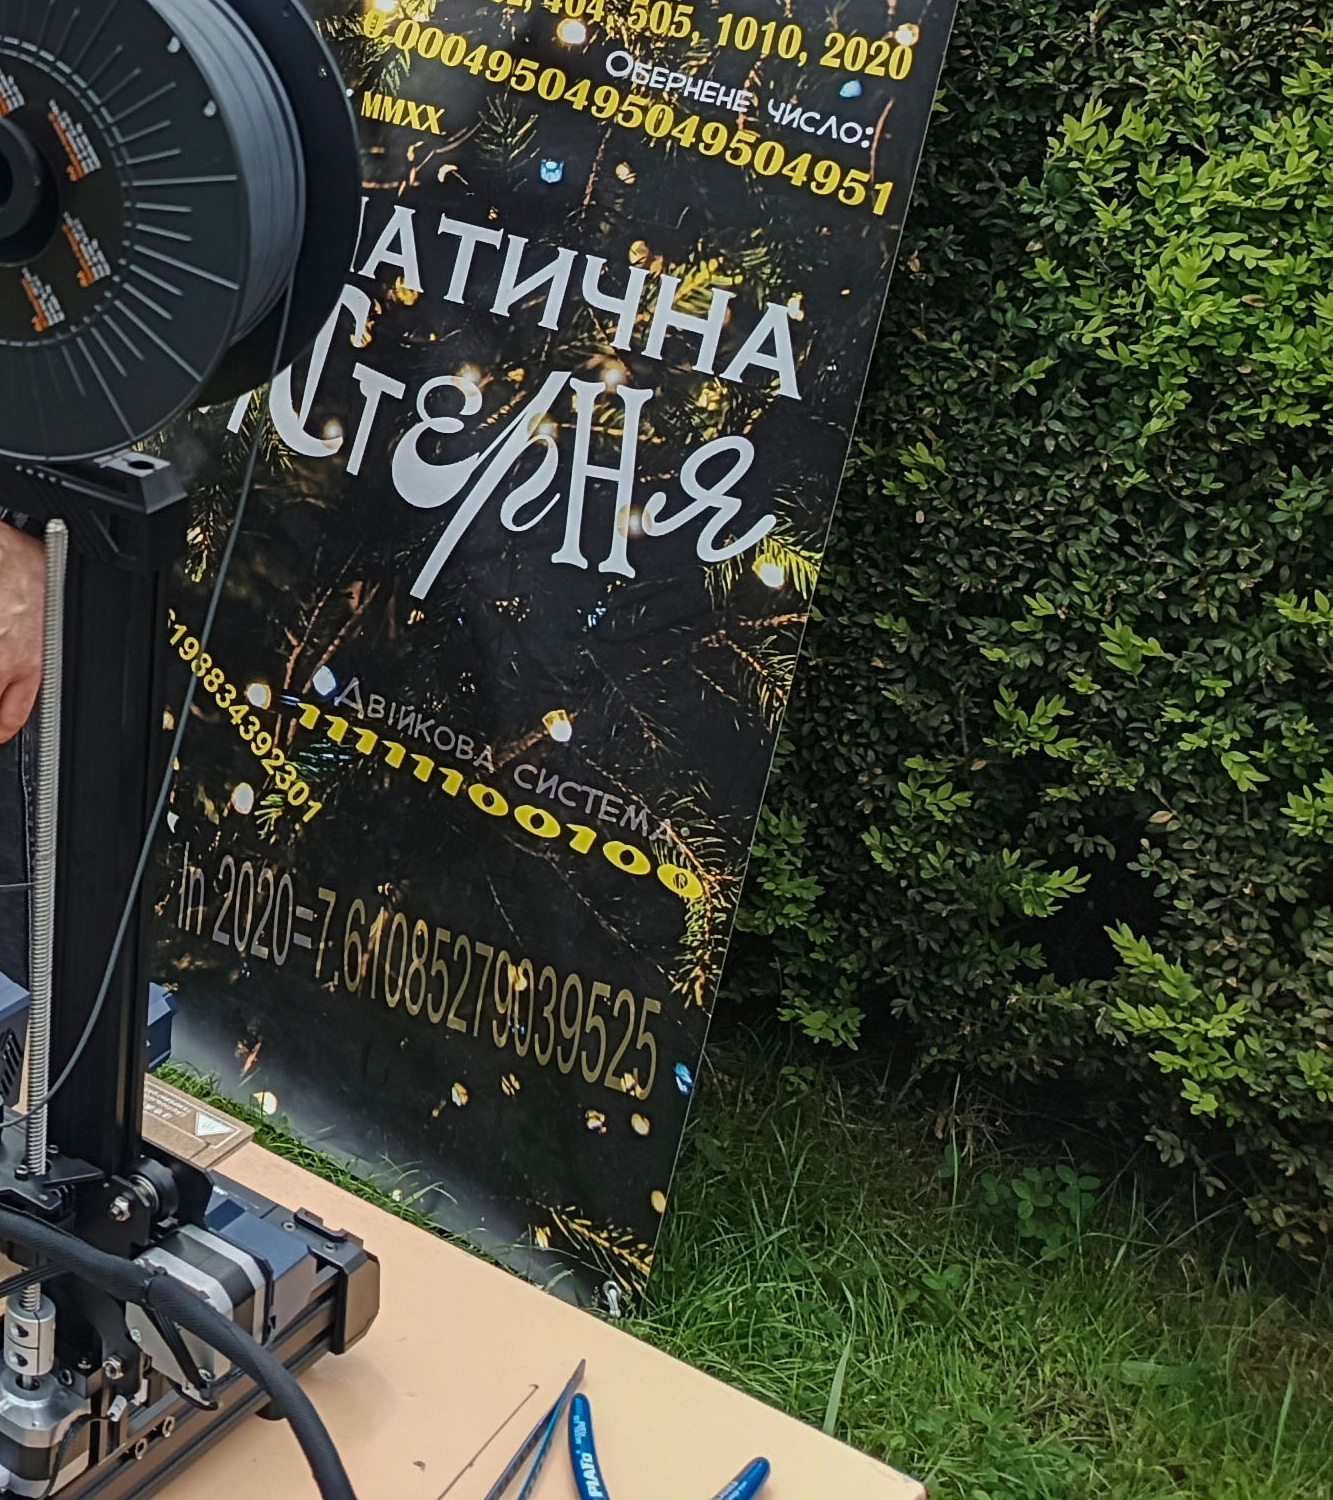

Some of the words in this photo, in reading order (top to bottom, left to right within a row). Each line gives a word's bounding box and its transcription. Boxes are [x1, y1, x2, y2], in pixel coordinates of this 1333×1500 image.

[716, 12, 809, 68] 1010,
[820, 31, 914, 81] 2020
[350, 195, 802, 400] АТИЧНА
[167, 607, 323, 823] 198834392301
